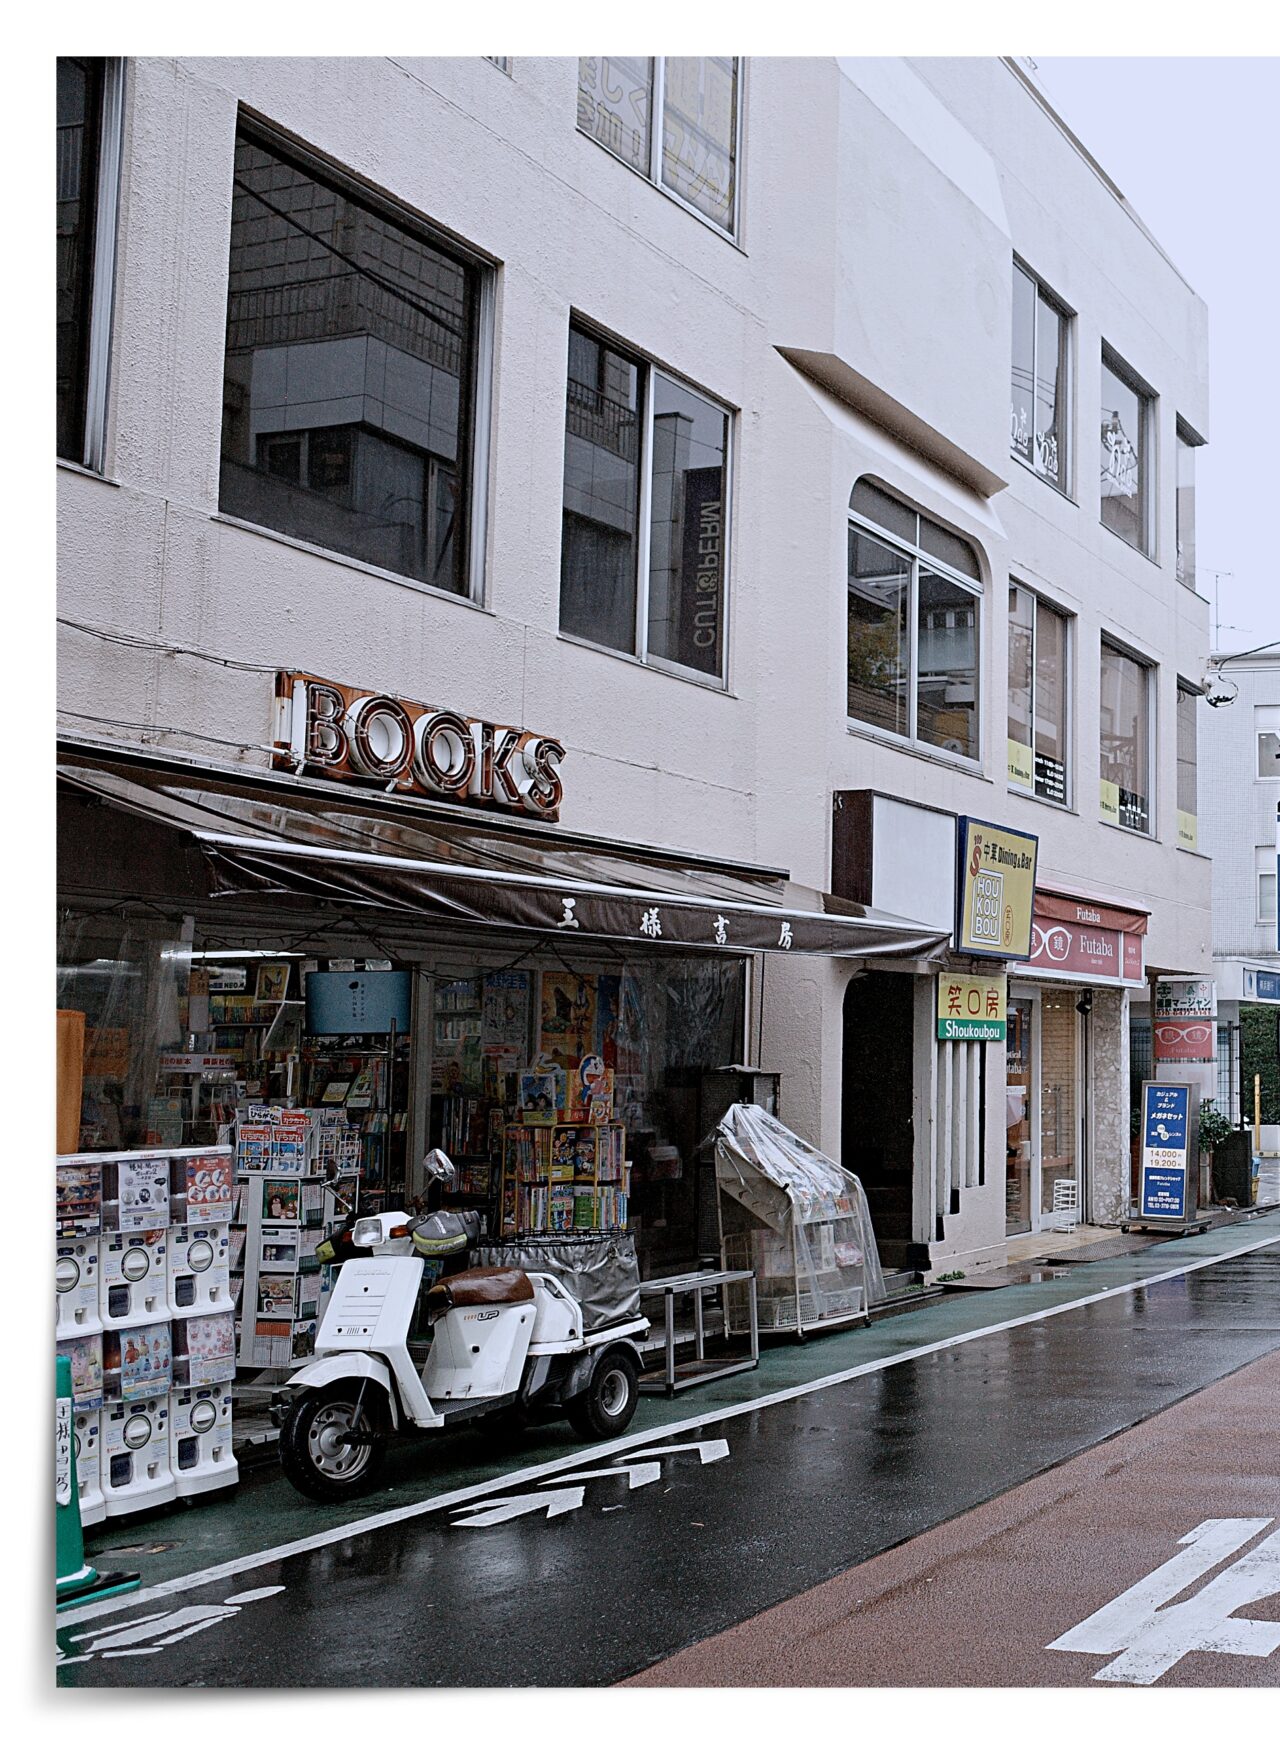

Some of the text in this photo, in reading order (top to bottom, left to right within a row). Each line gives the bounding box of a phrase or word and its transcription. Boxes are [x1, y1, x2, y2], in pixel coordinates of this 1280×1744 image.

[291, 680, 566, 814] BOOKS
[976, 897, 999, 917] KOU
[1076, 907, 1101, 923] Futaba
[975, 916, 998, 937] BOU
[1080, 934, 1113, 957] Futaba
[948, 985, 999, 1018] 笑口房
[945, 1021, 1000, 1040] Shoukoubou
[1150, 1112, 1184, 1120] メガネセット
[477, 1309, 500, 1322] UP
